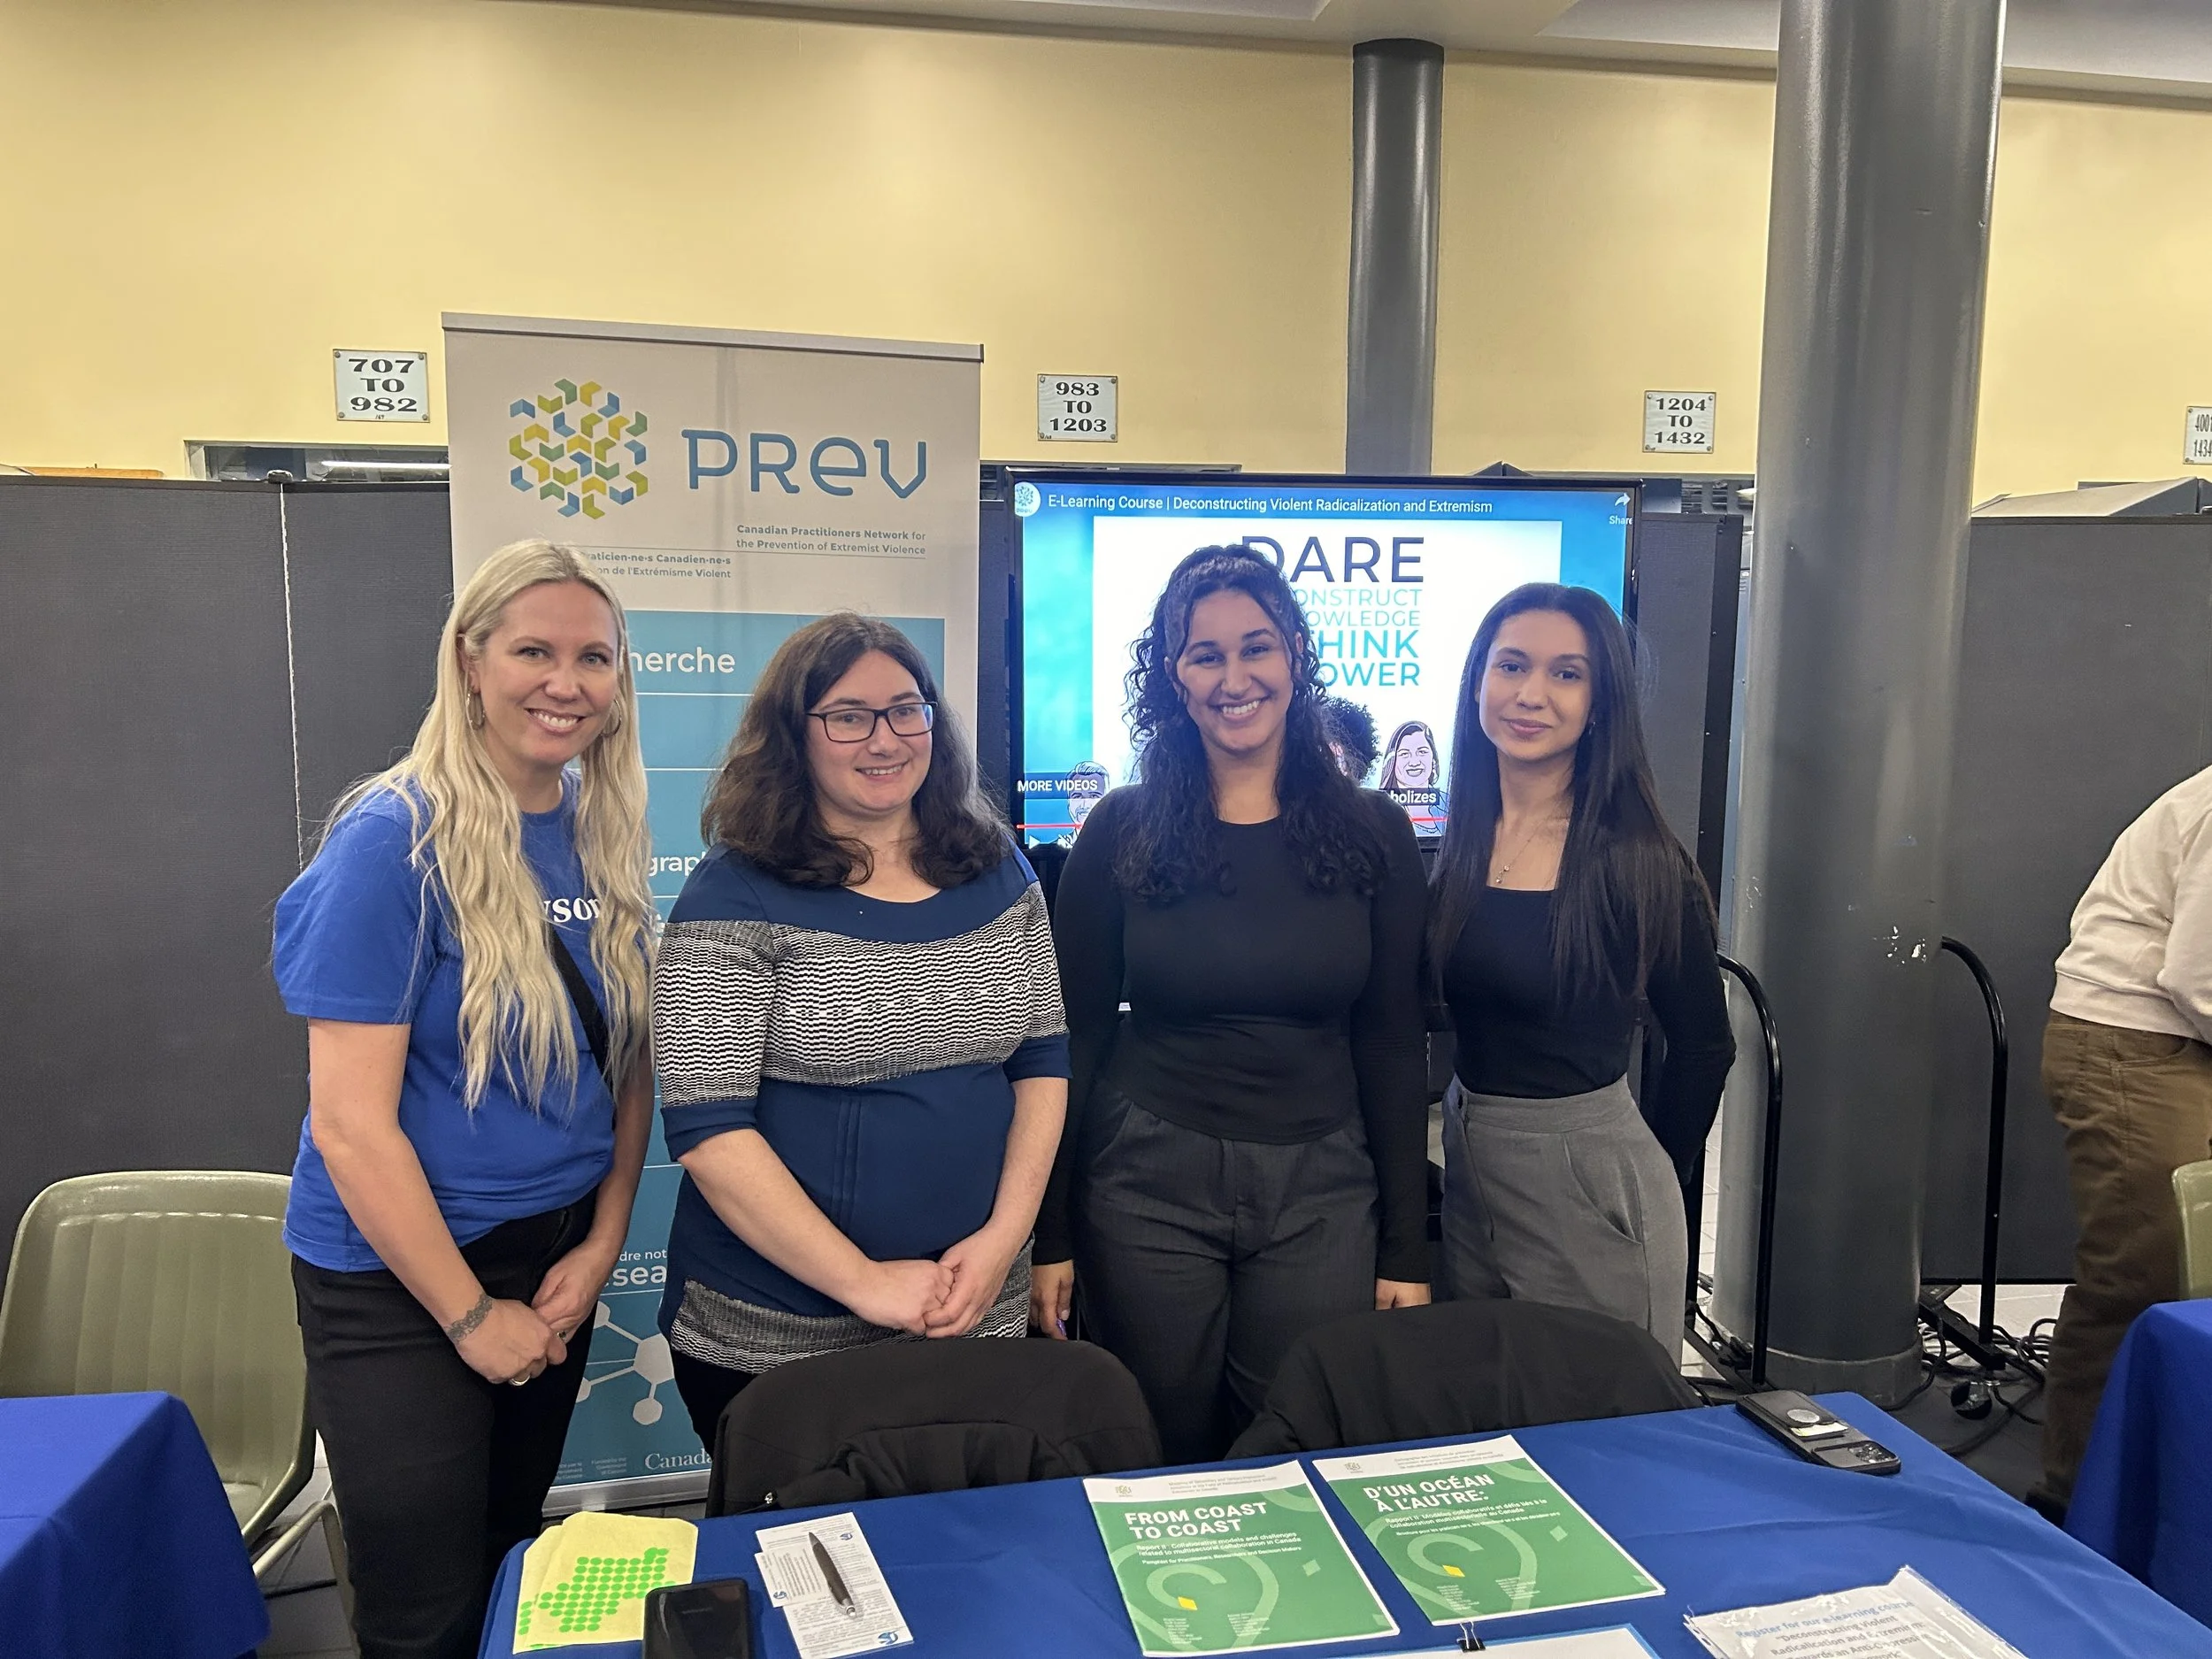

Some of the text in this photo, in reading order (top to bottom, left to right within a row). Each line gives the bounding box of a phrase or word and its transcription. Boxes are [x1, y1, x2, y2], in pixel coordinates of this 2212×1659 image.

[349, 358, 414, 373] 707
[360, 378, 404, 392] TO
[1056, 382, 1099, 396] 983
[350, 396, 417, 411] 982
[1064, 401, 1092, 413] TO
[1656, 398, 1706, 411] 1204
[1050, 418, 1106, 432] 1203
[1667, 415, 1692, 427] TO
[1655, 432, 1705, 444] 1432
[1048, 495, 1115, 511] E-Learning
[1118, 496, 1164, 510] Course
[1173, 497, 1267, 513] Deconstructing
[1270, 498, 1313, 511] Violent
[1316, 499, 1400, 512] Radicalization
[1403, 500, 1425, 512] and
[1429, 500, 1493, 513] Extremism
[737, 525, 926, 541] Canadian Practitioners Network for
[736, 539, 926, 555] the Prevention of Extremist Violence
[612, 566, 625, 575] de
[627, 566, 693, 577] l'Extrémisme
[695, 569, 731, 578] Violent
[1294, 588, 1422, 606] ONSTRUCT
[1307, 611, 1420, 626] OWLEDGE
[1311, 630, 1419, 658] HINK
[1320, 662, 1420, 687] OWER
[1017, 779, 1097, 792] MORE VIDEOS
[645, 1249, 667, 1260] not
[607, 1265, 667, 1286] sea
[1363, 1474, 1495, 1500] D'UN OCÉAN
[1373, 1489, 1489, 1513] À L'AUTRE:
[1124, 1502, 1267, 1525] FROM COAST
[1129, 1518, 1241, 1540] TO COAST
[1390, 1519, 1434, 1528] collaboration
[1171, 1540, 1217, 1549] Collaborative
[1260, 1532, 1297, 1540] challenges
[1220, 1540, 1265, 1549] collaboration
[1735, 1624, 1781, 1638] Register
[1801, 1617, 1821, 1626] our
[1823, 1607, 1880, 1624] e-learning
[1860, 1615, 1898, 1628] Violent
[1846, 1632, 1867, 1642] and
